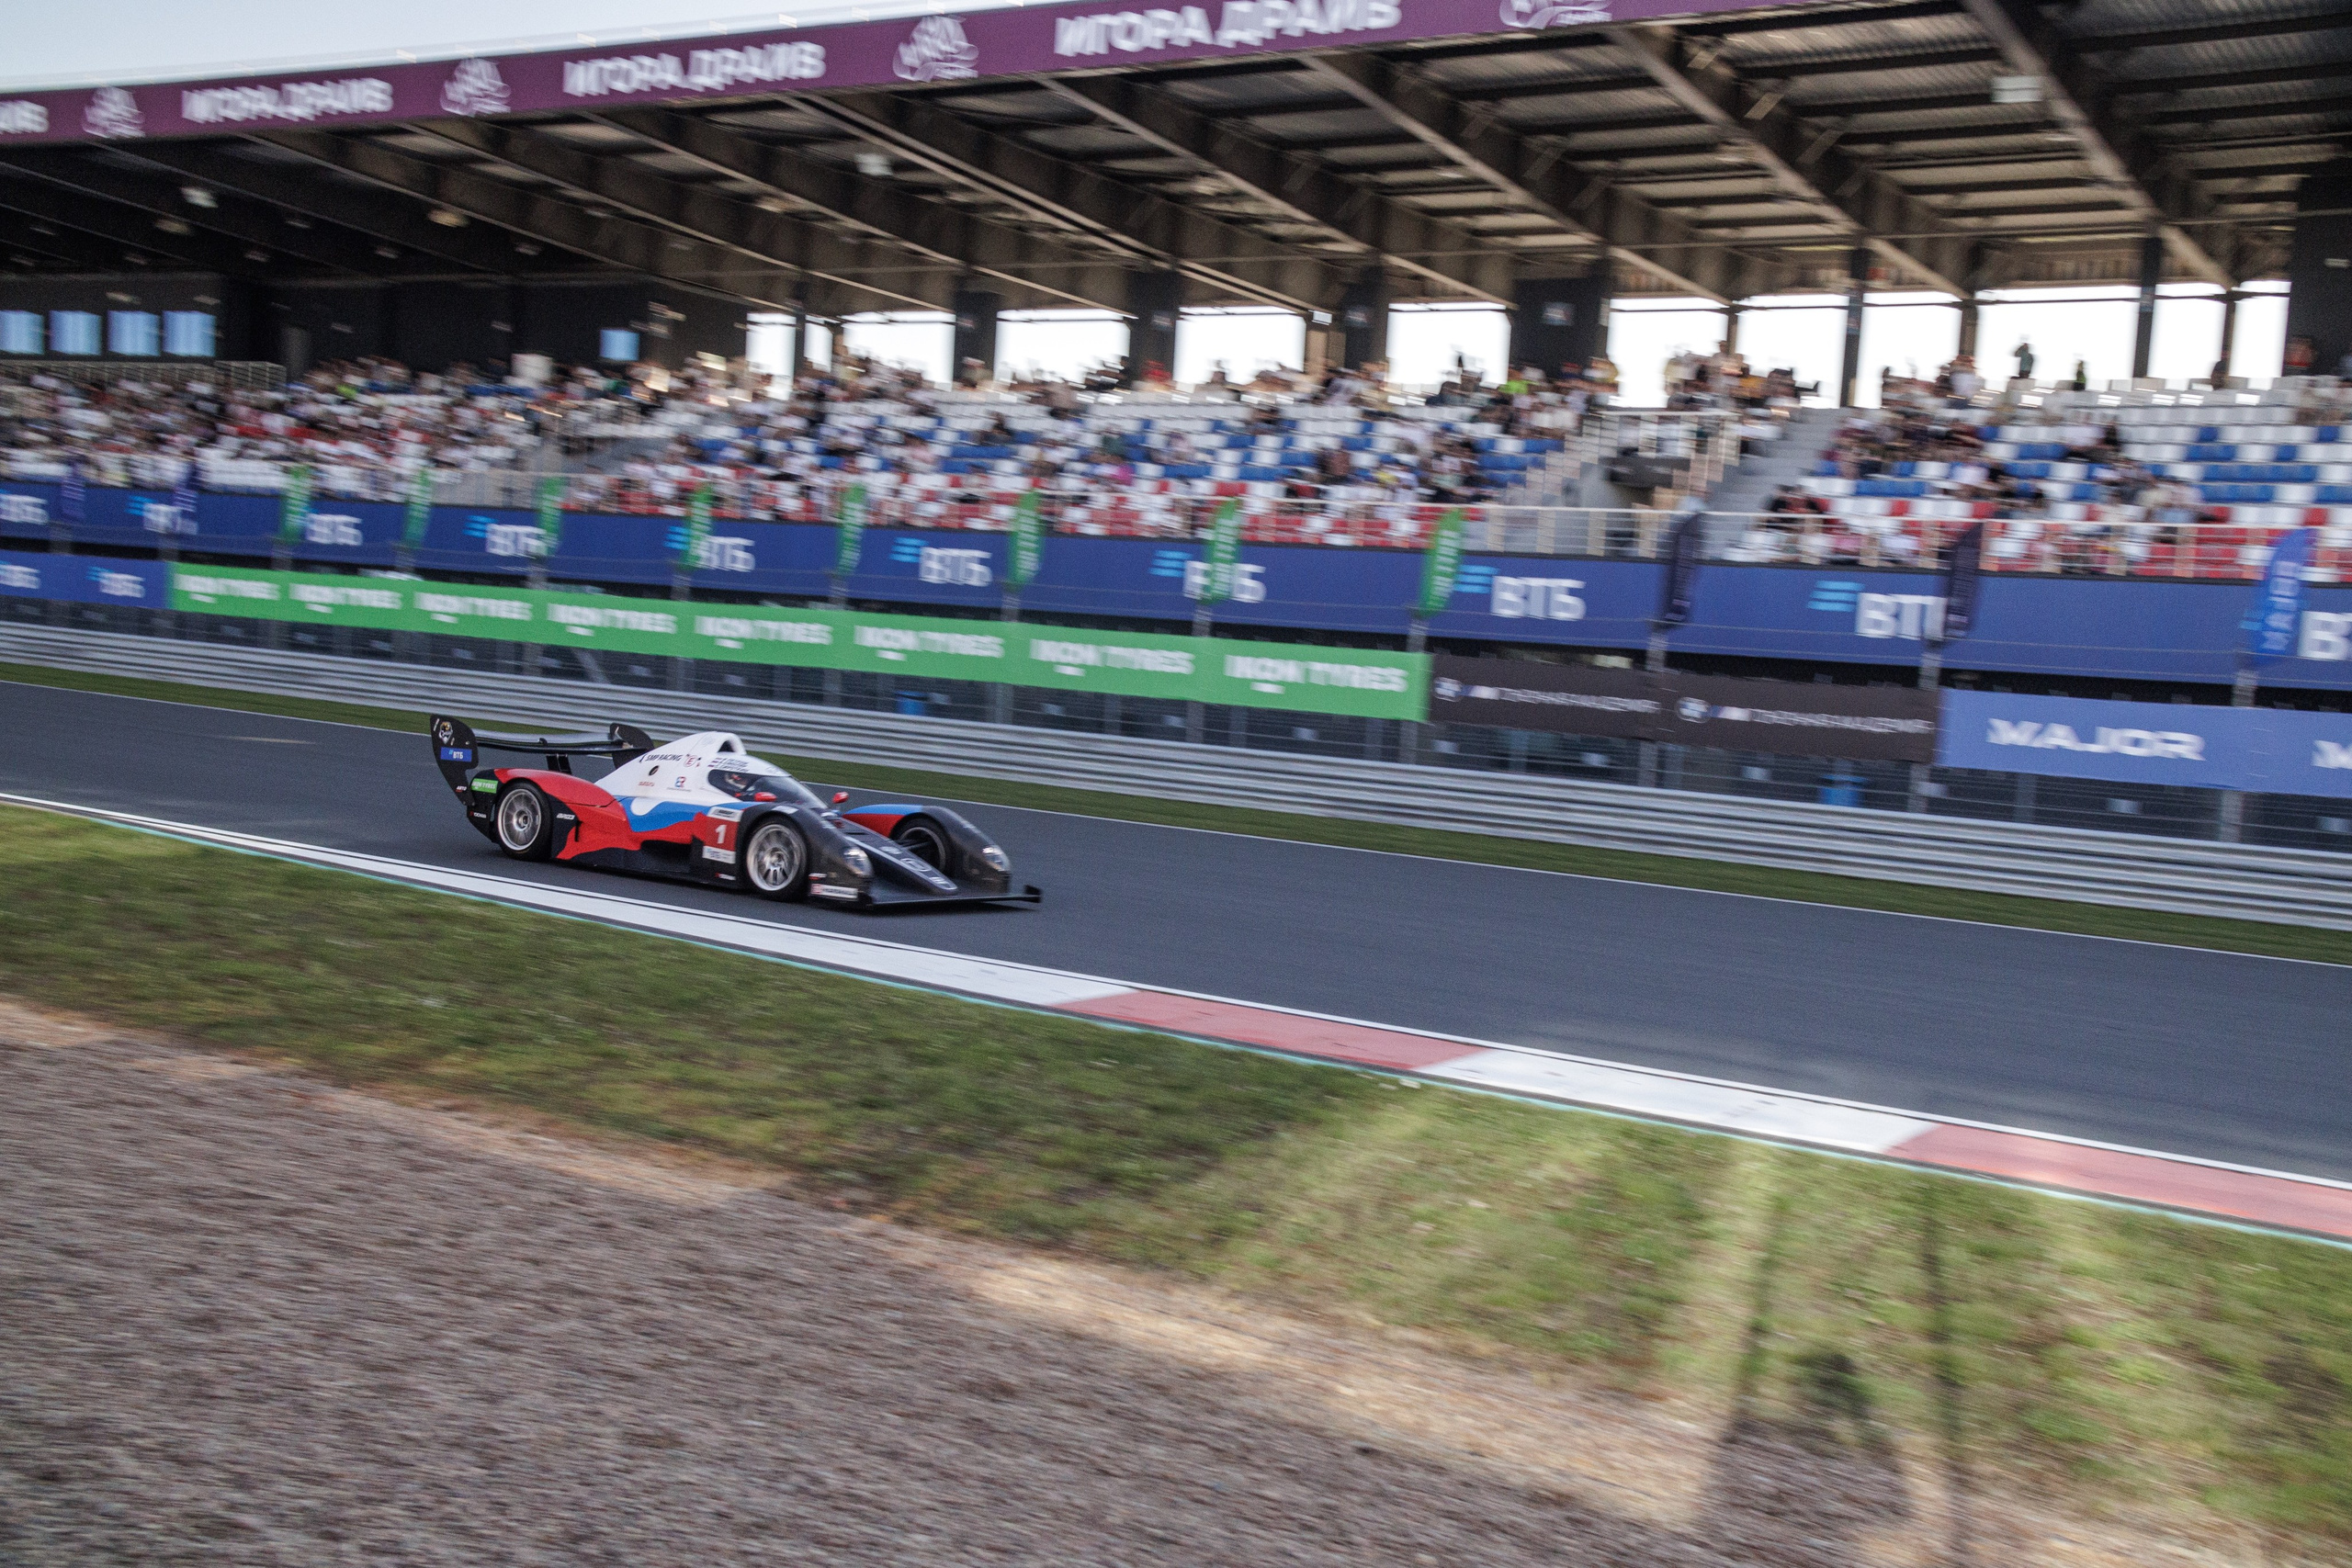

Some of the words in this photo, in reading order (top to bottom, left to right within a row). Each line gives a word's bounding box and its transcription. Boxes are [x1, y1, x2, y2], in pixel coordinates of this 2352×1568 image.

[1054, 6, 1214, 57] ИГОРА
[563, 53, 684, 97] ИГОРА
[1182, 560, 1267, 603] ВБ
[1491, 576, 1586, 620] ВТБ
[453, 750, 464, 760] ВТБ
[1986, 718, 2205, 761] MAJOR
[716, 824, 728, 844] 1
